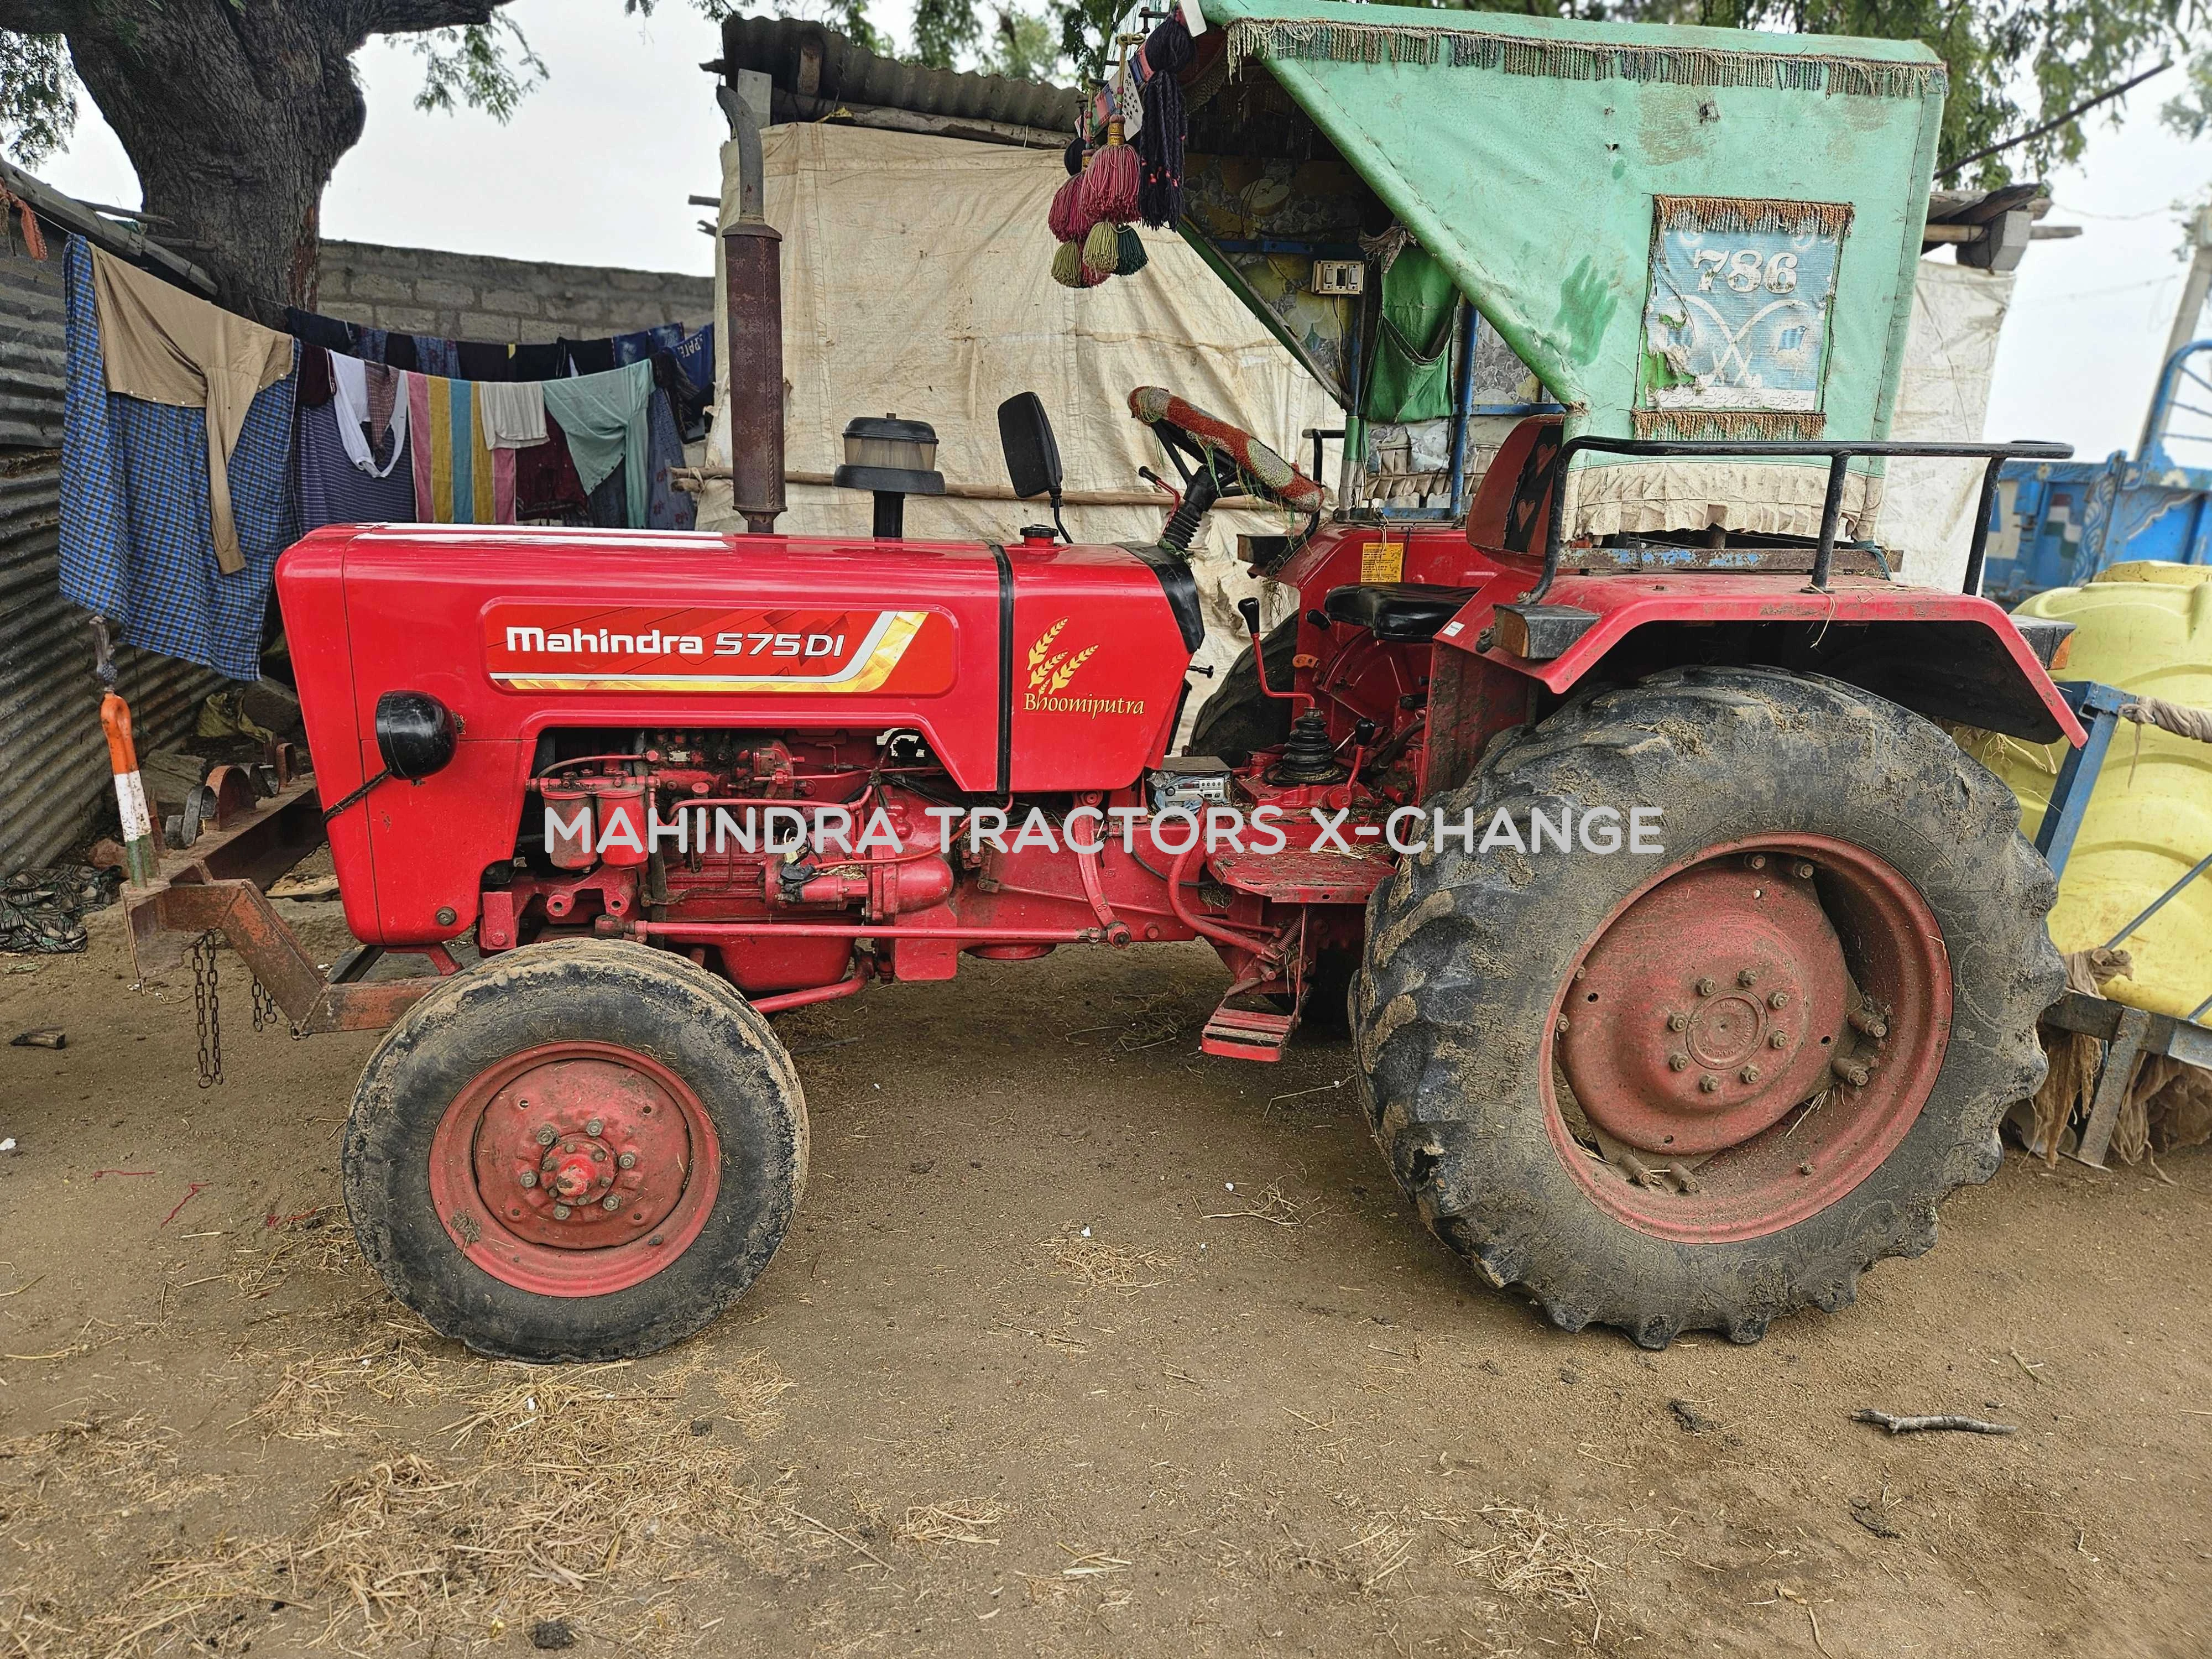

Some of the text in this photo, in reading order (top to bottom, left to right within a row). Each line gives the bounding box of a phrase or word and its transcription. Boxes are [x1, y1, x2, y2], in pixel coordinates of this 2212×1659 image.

[1693, 249, 1799, 294] 786
[507, 627, 844, 657] Mahindra 575DI
[1023, 692, 1145, 719] Bhoomiputra
